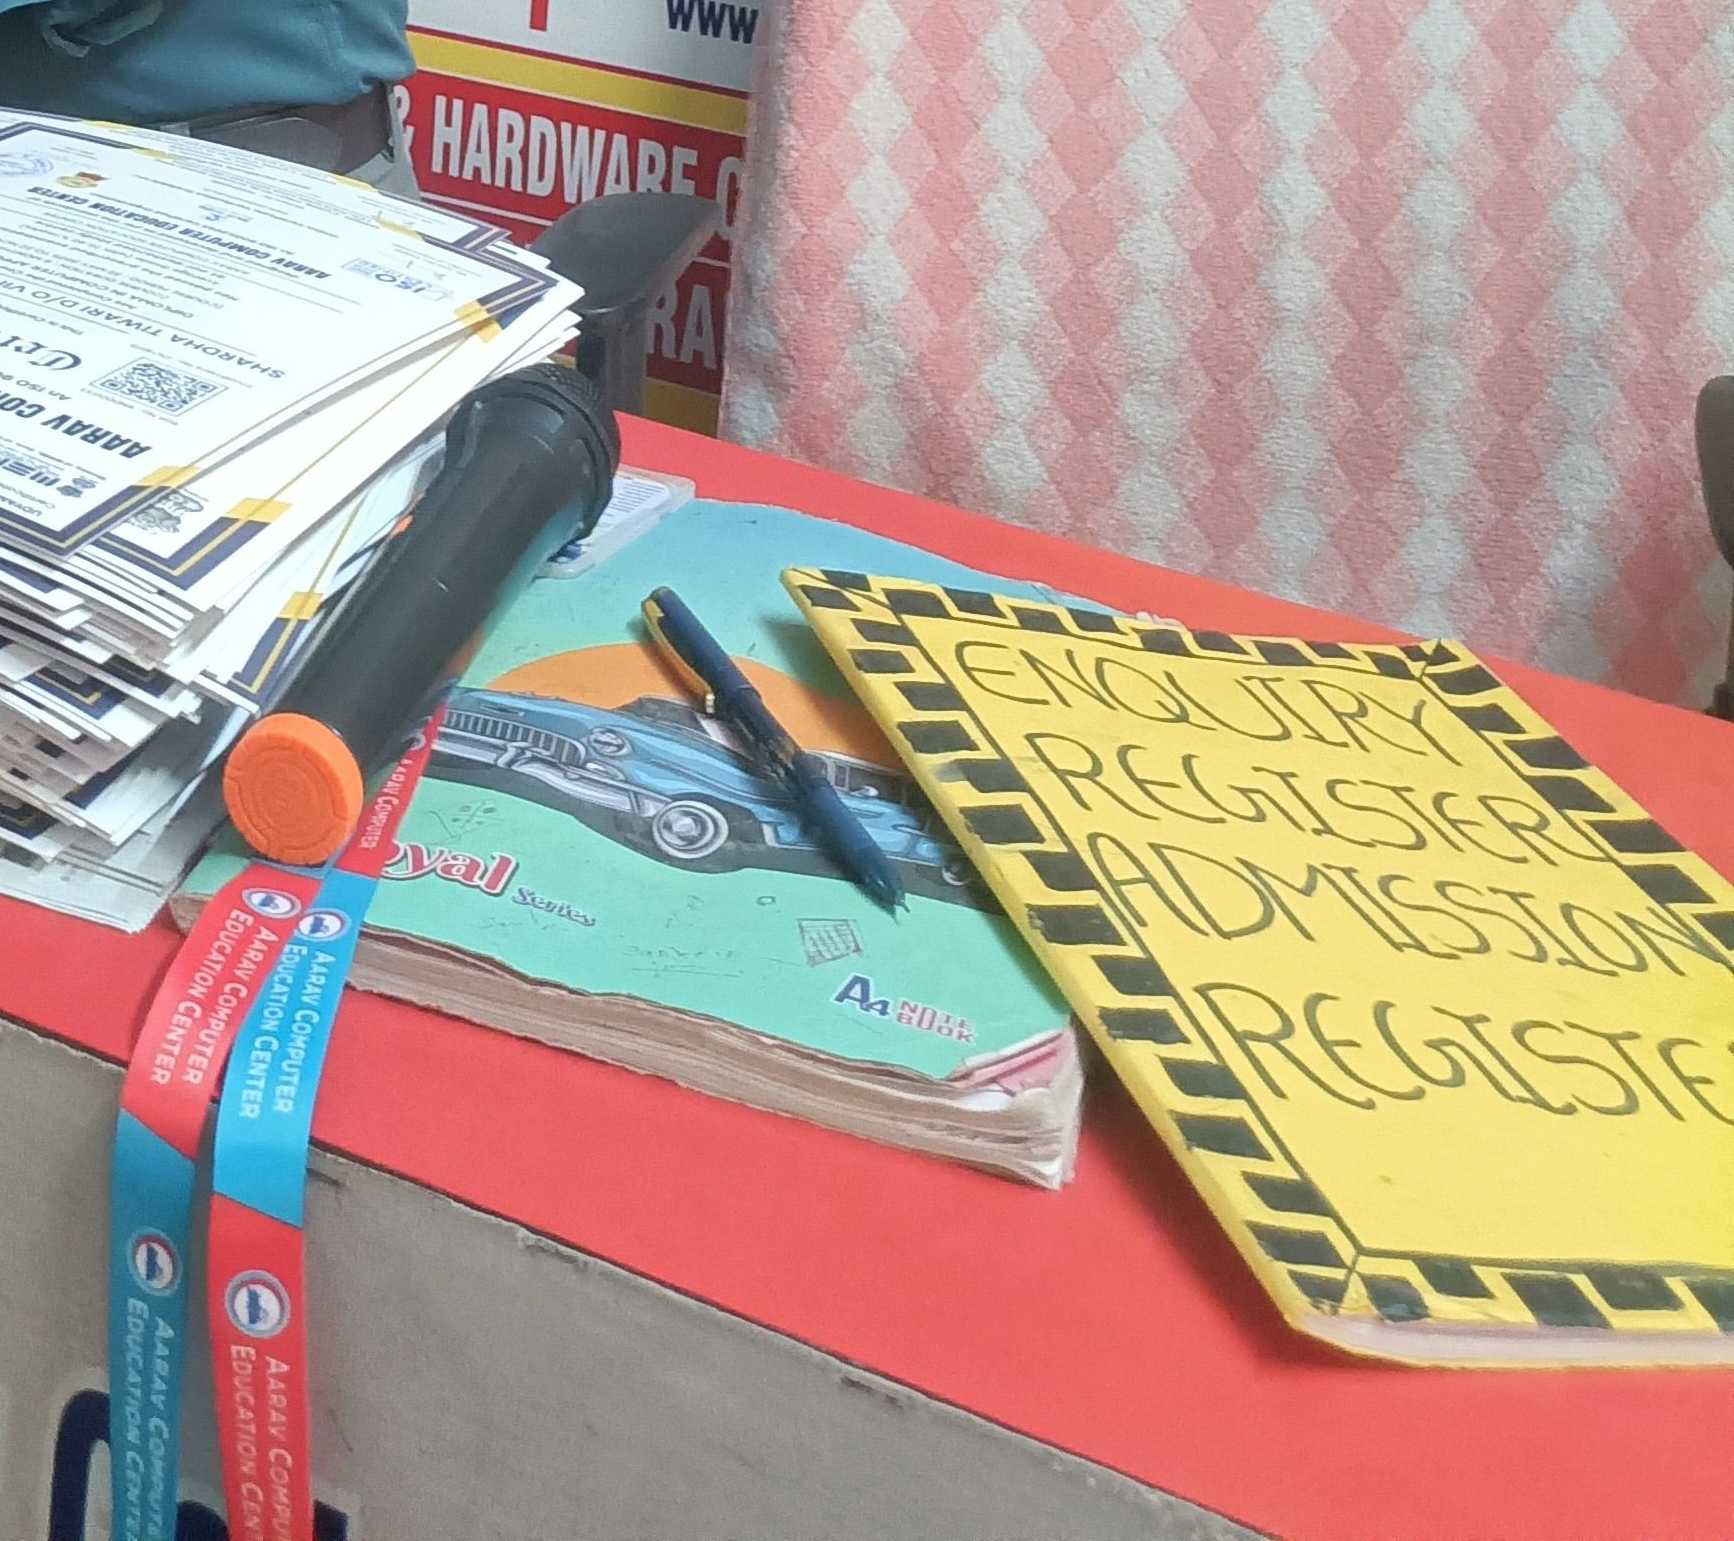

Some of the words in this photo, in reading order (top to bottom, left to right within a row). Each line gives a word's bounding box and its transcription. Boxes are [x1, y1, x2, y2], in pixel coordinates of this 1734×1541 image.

[432, 95, 699, 206] HARDWARE
[26, 184, 91, 207] CENTER
[85, 196, 179, 231] EDUCATION
[178, 223, 271, 262] COMPUTER
[264, 256, 333, 282] AARAV
[31, 289, 80, 309] D/O
[79, 305, 163, 337] TIWARI
[15, 379, 46, 393] ISO
[168, 332, 286, 379] SHARDHA
[40, 413, 152, 459] AARAV
[954, 640, 1463, 767] ENQUIRY
[1025, 731, 1607, 866] REGISTER
[1088, 829, 1734, 978] ADMISSION
[188, 908, 254, 1000] EDUCATION
[234, 925, 279, 981] AARAV
[260, 944, 307, 1031] EDUCATION
[301, 951, 335, 1006] AARAV
[834, 975, 891, 1016] A4
[151, 1000, 202, 1086] CENTER
[183, 983, 248, 1085] COMPUTER
[273, 1010, 320, 1114] COMPUTER
[239, 1036, 279, 1119] CENTER
[231, 1345, 256, 1477] EDUCATION
[266, 1354, 290, 1442] AARAV
